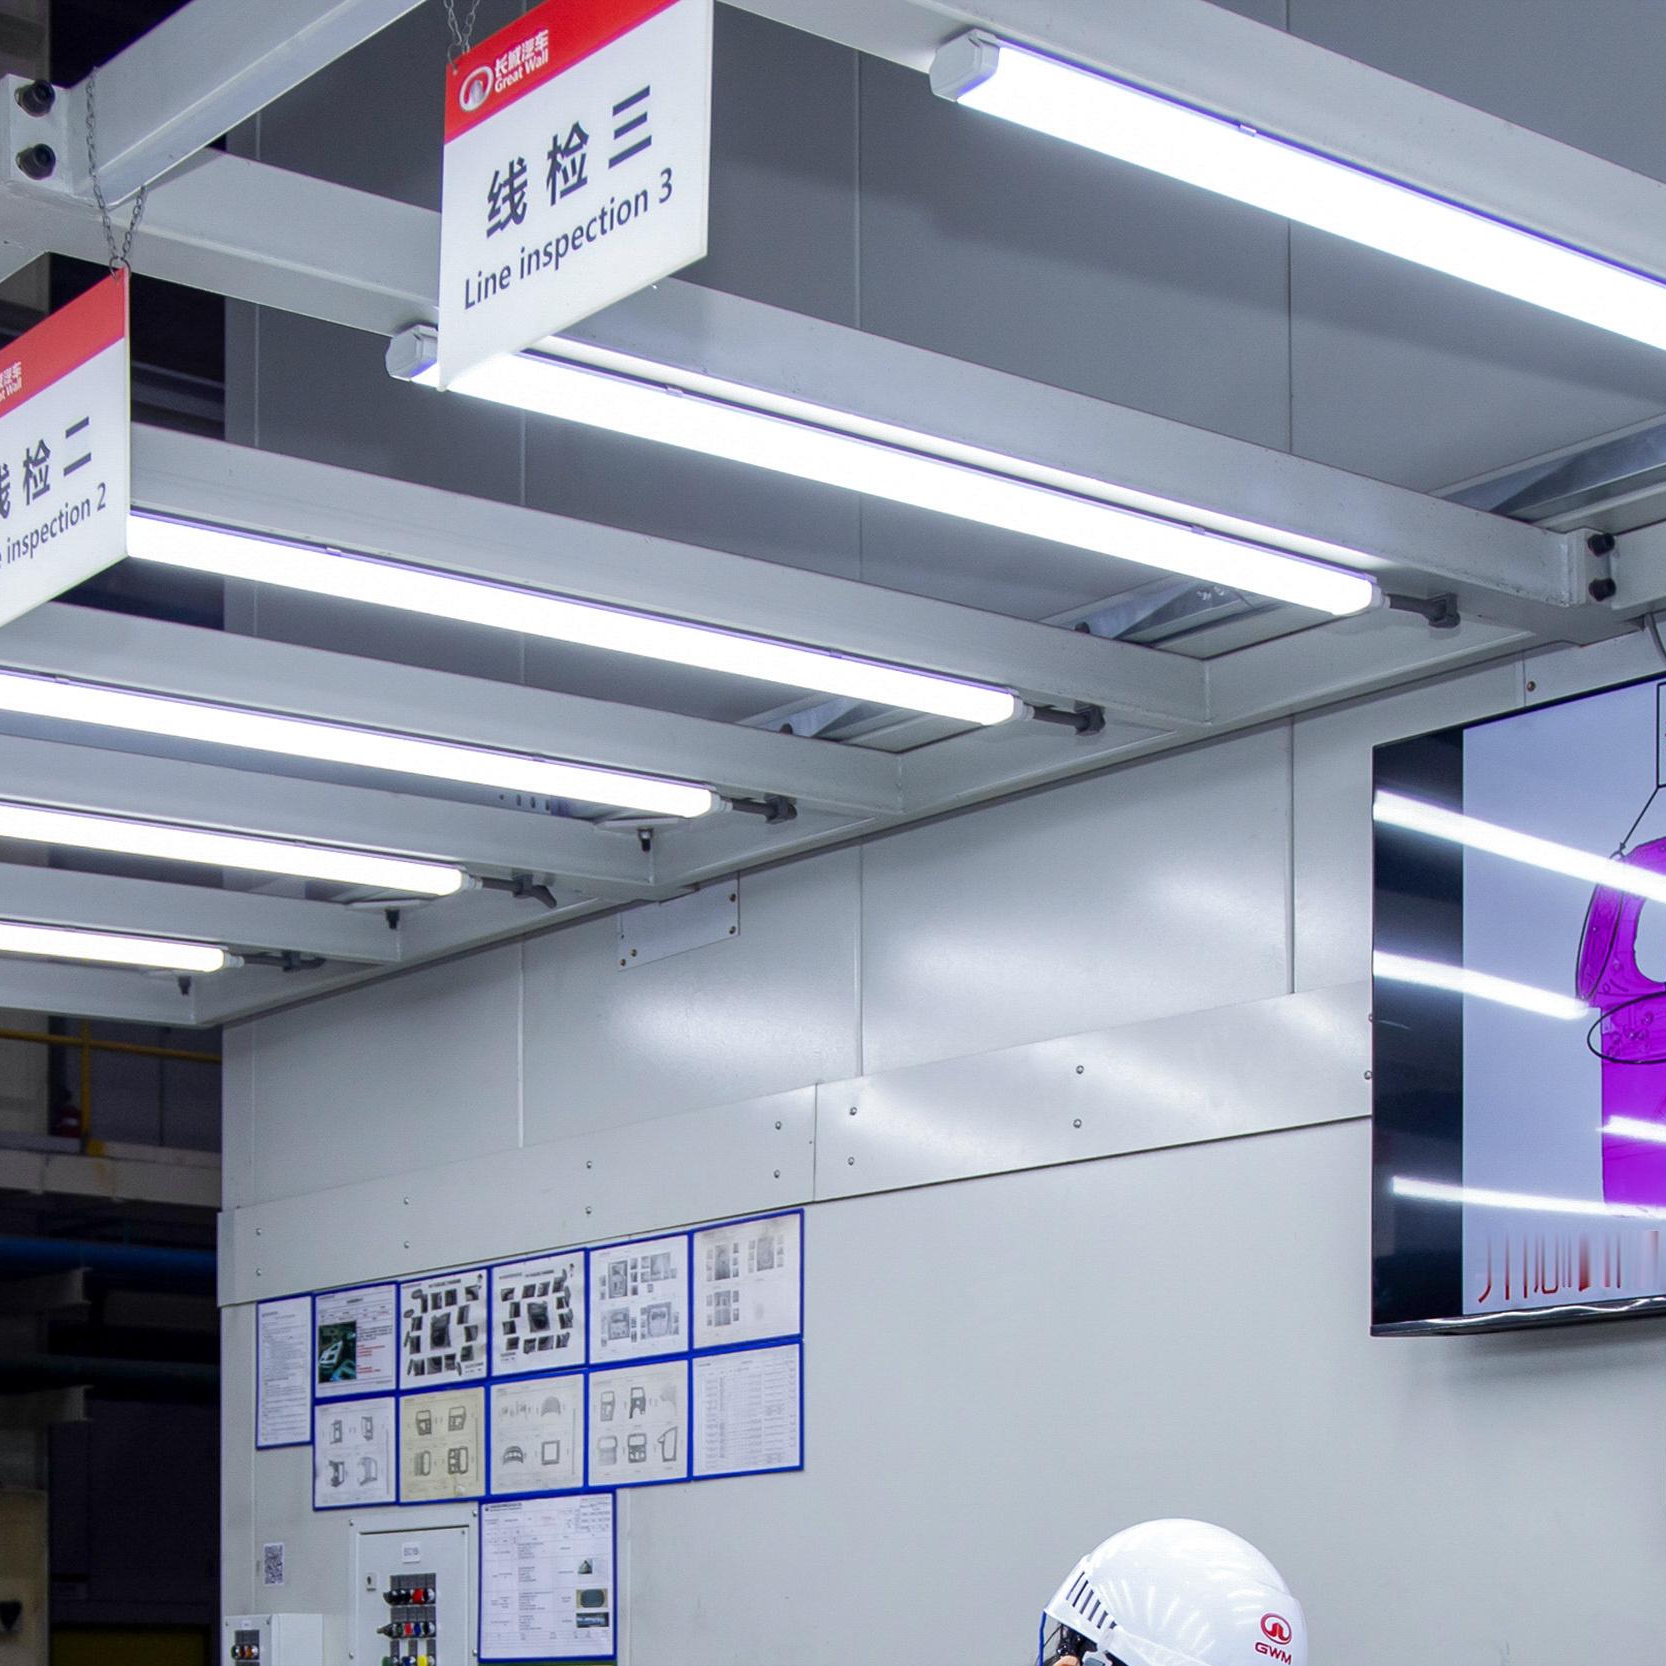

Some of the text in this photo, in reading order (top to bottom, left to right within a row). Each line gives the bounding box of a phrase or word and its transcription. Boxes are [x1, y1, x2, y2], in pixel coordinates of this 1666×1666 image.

[494, 48, 549, 93] Great Wall
[485, 84, 653, 238] 线检三
[464, 167, 674, 310] Line inspection 3
[5, 376, 23, 396] Wall
[6, 502, 91, 563] inspection
[96, 482, 108, 510] 2
[1254, 1641, 1293, 1666] GWM
